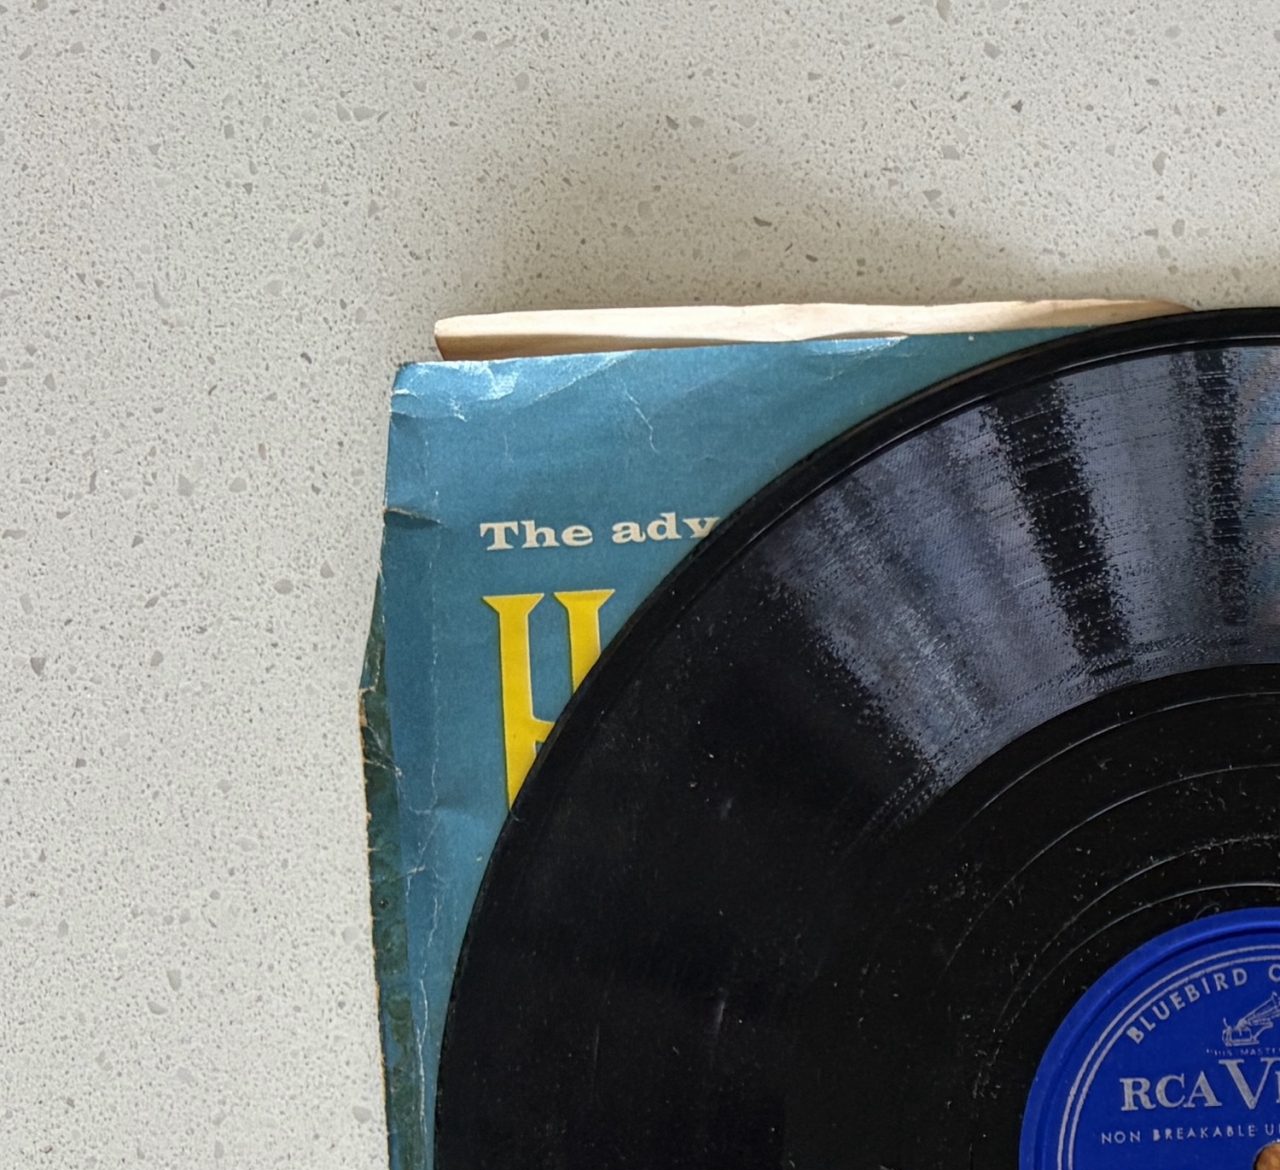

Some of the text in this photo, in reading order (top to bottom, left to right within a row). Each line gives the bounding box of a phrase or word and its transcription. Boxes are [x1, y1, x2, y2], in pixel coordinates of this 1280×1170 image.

[480, 520, 594, 551] The
[1126, 967, 1248, 1045] BLUEBIRD
[1119, 1070, 1223, 1112] RCA
[1101, 1131, 1141, 1145] NON
[1153, 1124, 1256, 1142] BREAKABLE
